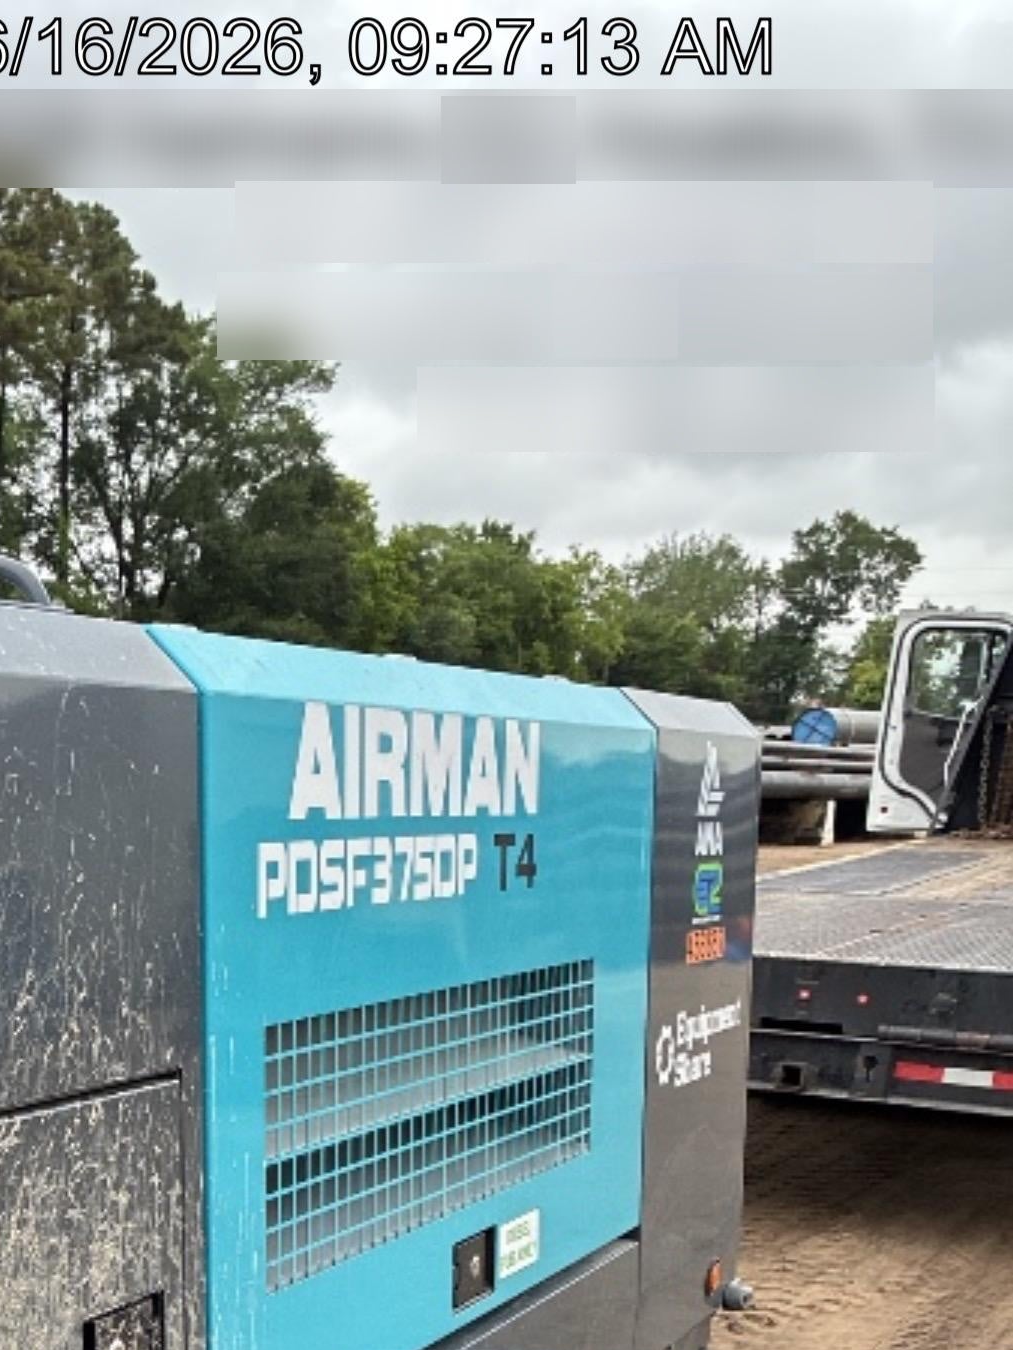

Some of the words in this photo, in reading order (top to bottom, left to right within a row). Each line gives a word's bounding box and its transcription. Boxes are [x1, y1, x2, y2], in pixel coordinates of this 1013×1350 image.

[288, 701, 541, 820] AIRMAN
[257, 832, 477, 920] PDSF375DP
[493, 832, 538, 893] T4
[675, 996, 741, 1050] Equipment
[673, 1051, 712, 1088] Share
